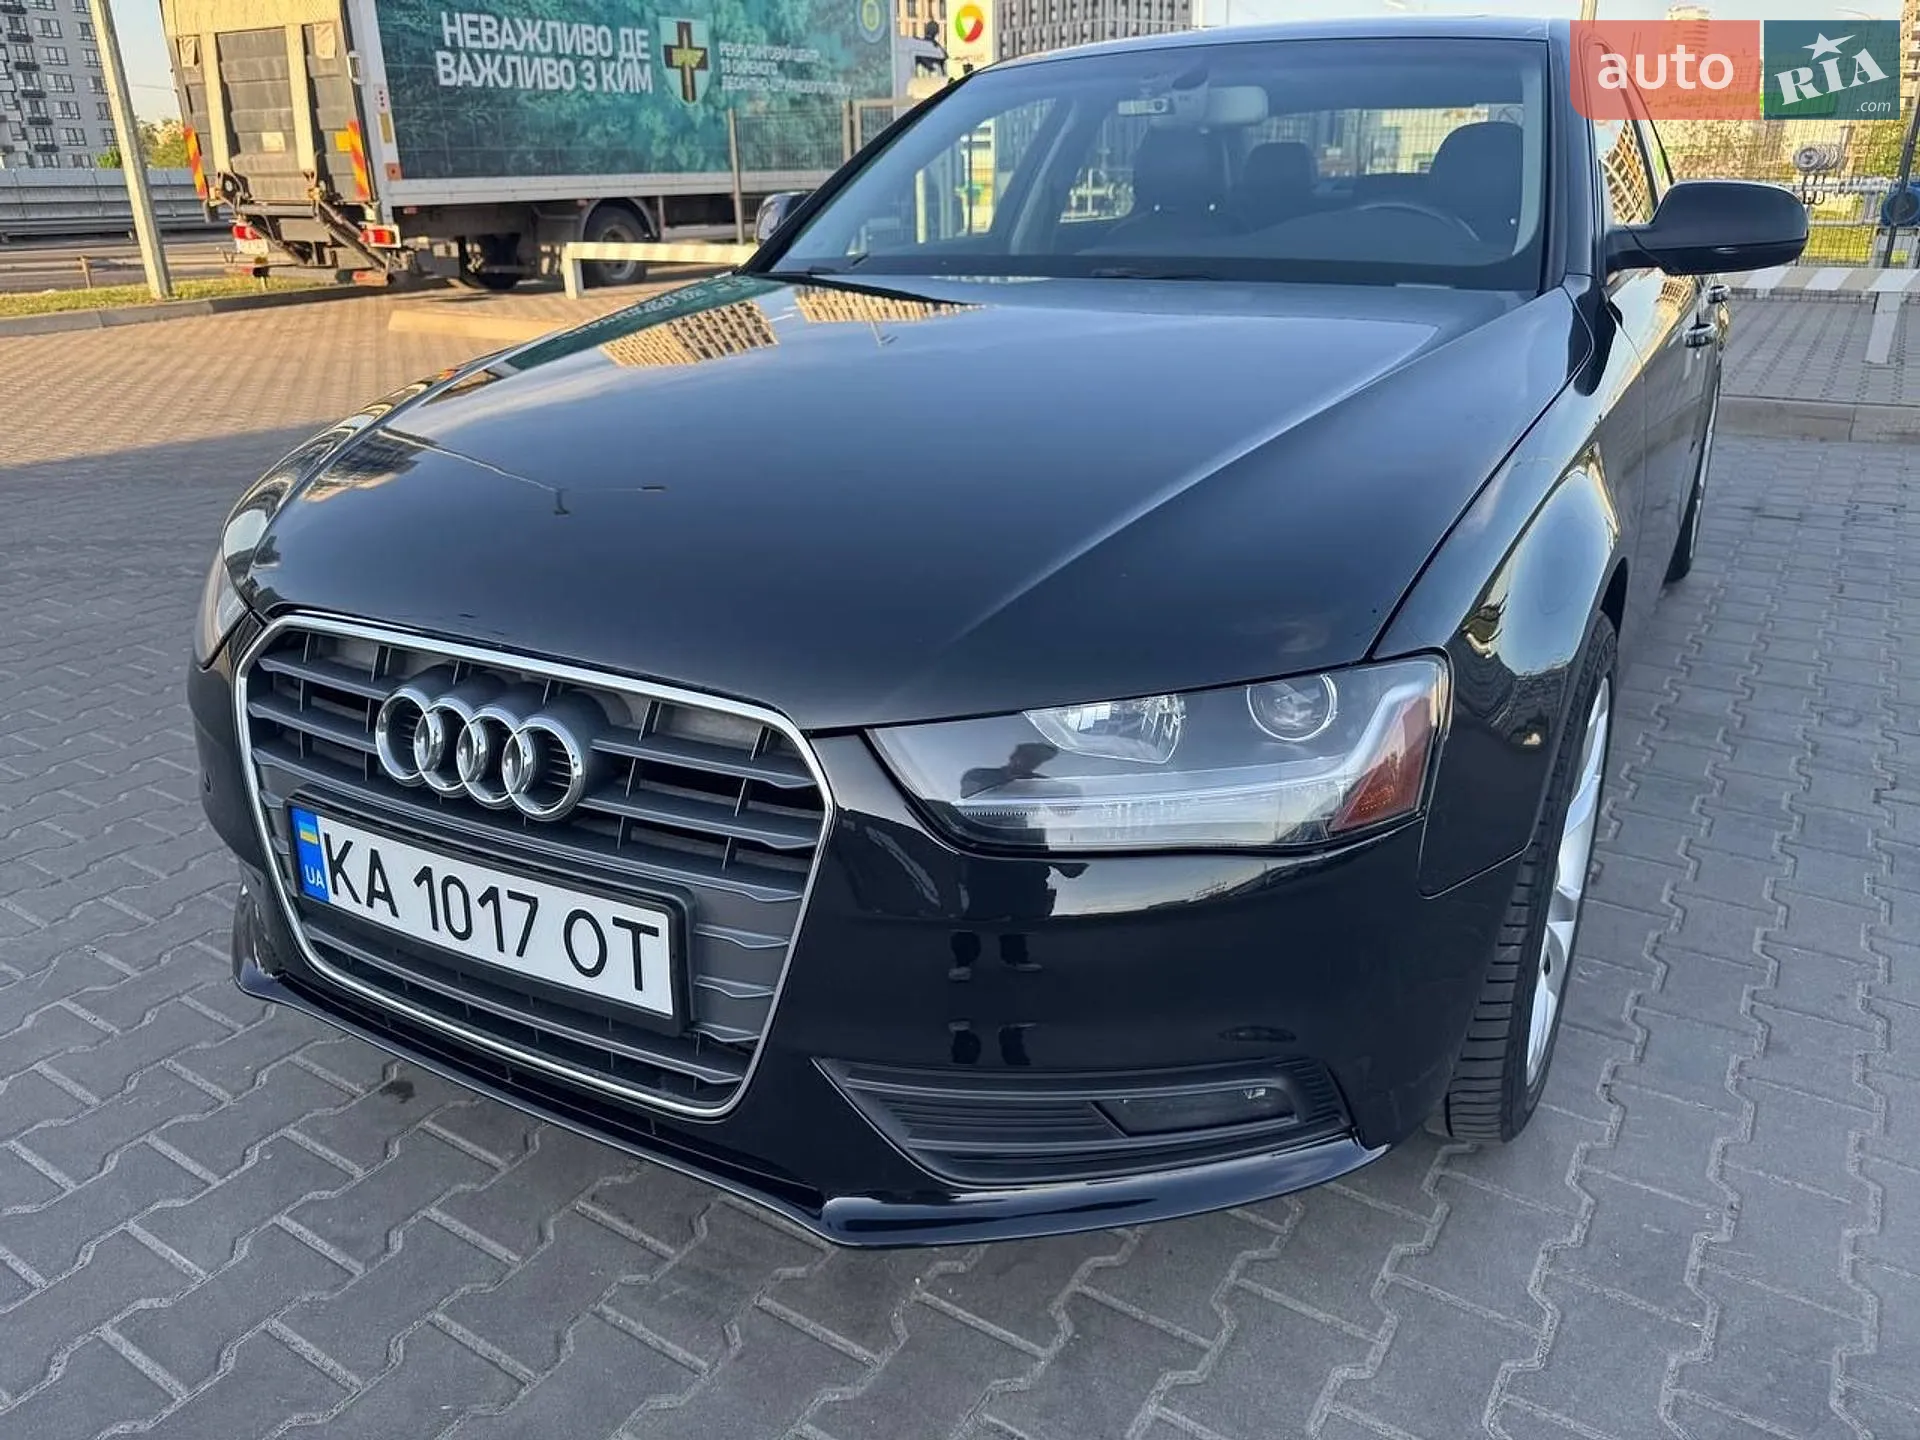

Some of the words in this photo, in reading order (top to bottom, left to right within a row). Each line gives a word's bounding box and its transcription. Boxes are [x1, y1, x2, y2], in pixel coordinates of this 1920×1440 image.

[441, 11, 613, 58] НЕВАЖЛИВО
[618, 27, 652, 63] ДЕ
[435, 50, 577, 91] ВАЖЛИВО
[601, 60, 653, 95] КИМ
[305, 865, 326, 889] UA
[323, 832, 399, 919] KA
[414, 866, 538, 958] 1017
[563, 909, 660, 992] OT
